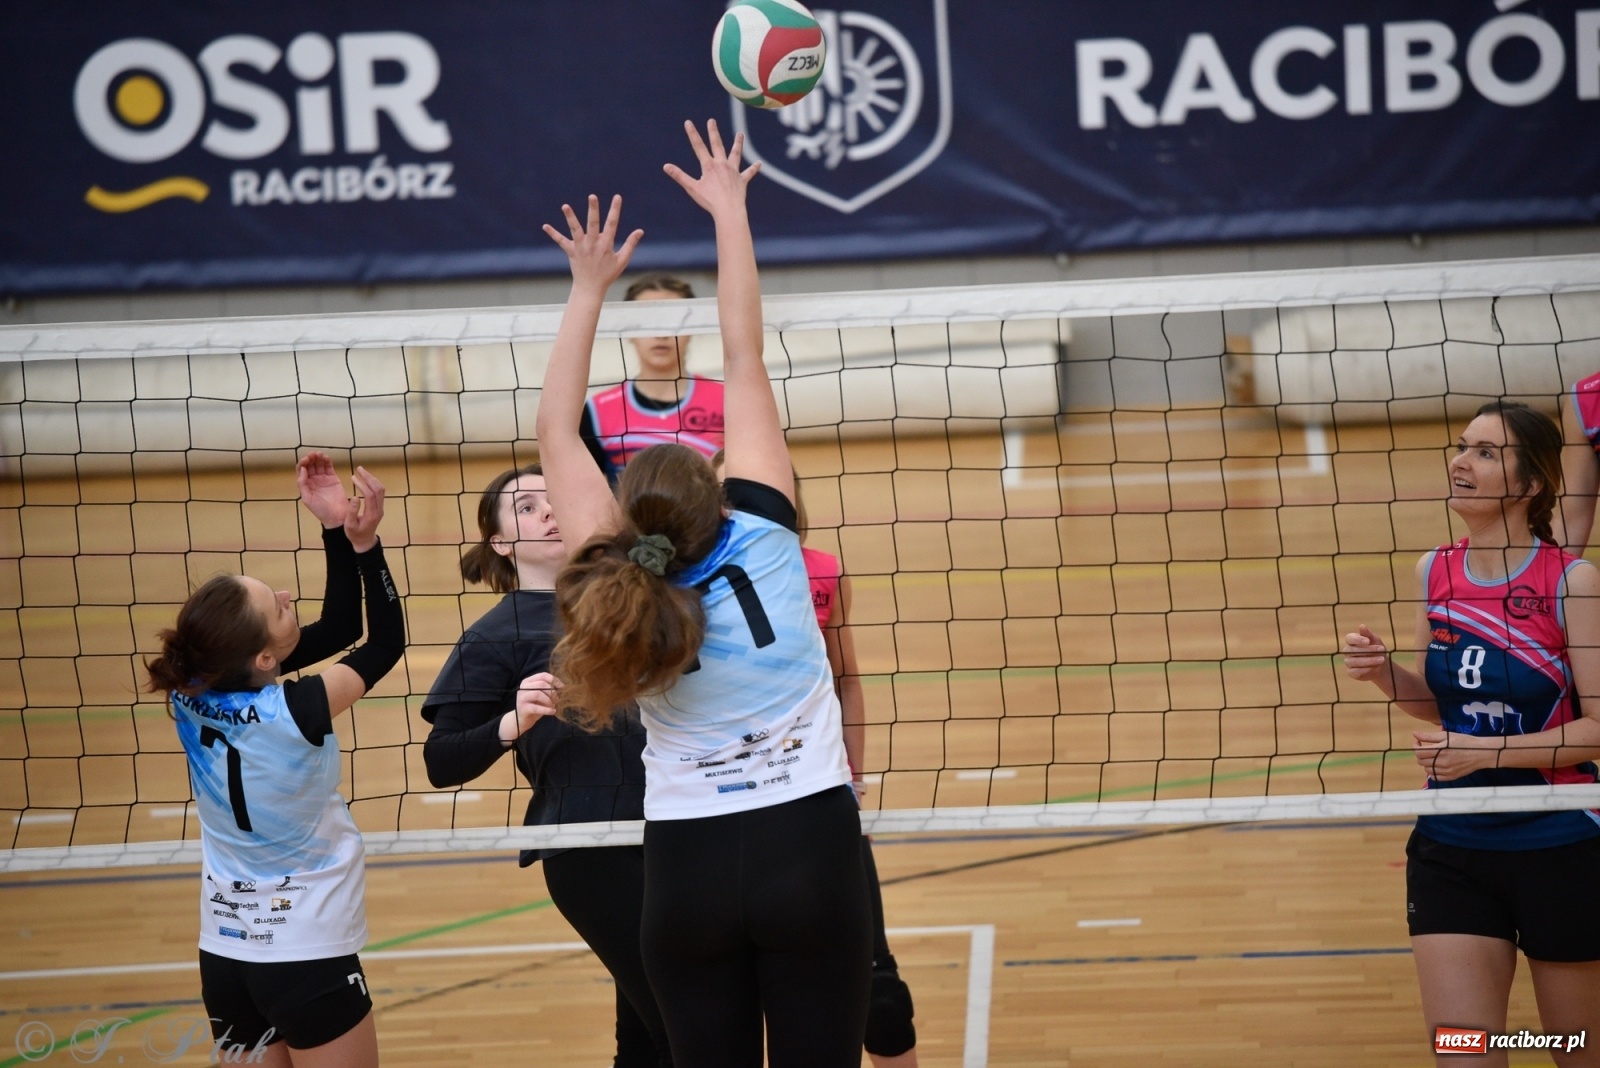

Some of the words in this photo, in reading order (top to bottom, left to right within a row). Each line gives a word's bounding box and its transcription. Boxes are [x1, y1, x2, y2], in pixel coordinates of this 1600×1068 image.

[788, 55, 820, 71] MECZ
[1075, 0, 1600, 130] RACIBÓ
[74, 31, 452, 163] OSiR
[230, 156, 456, 206] RACIBÓRZ
[1458, 645, 1486, 689] 8
[200, 725, 253, 832] 7
[705, 767, 743, 778] MULTISERWIS
[347, 972, 367, 996] 7
